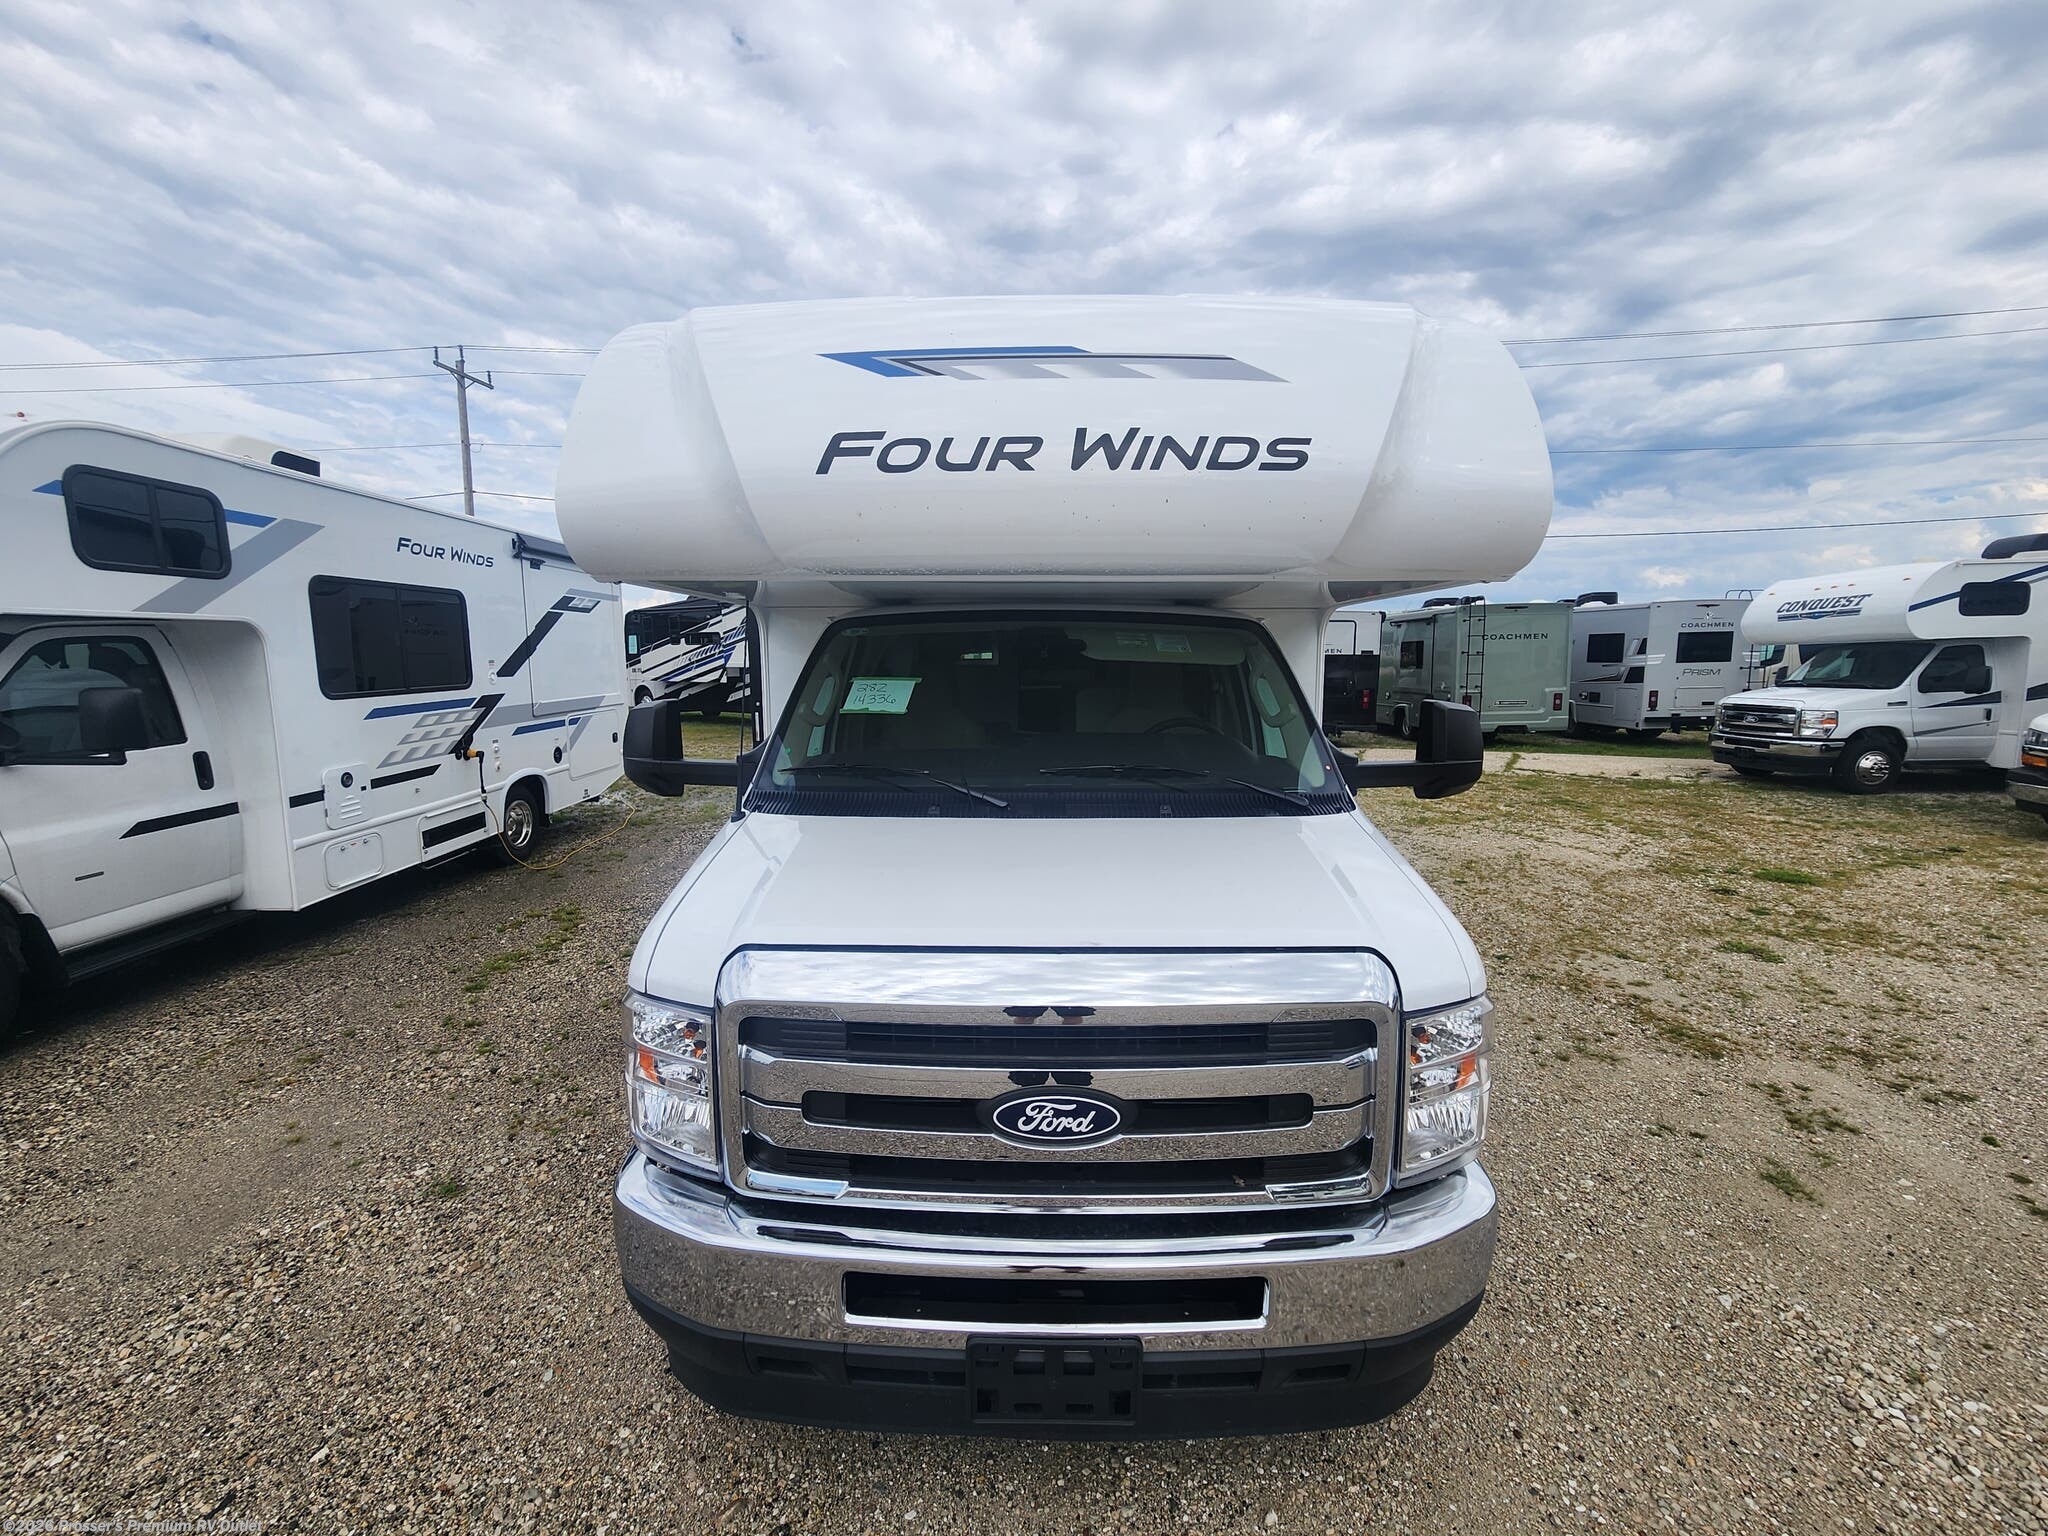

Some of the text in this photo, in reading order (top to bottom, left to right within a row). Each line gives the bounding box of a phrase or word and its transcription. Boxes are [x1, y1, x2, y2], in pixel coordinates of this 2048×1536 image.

[815, 426, 1313, 475] FOUR WINDS
[397, 536, 495, 568] FOUR WINDS
[1776, 593, 1873, 613] CONQUEST
[1482, 632, 1549, 641] COACHMEN
[1682, 668, 1721, 676] PRISM
[856, 682, 888, 693] 282
[1017, 1101, 1097, 1132] Ford
